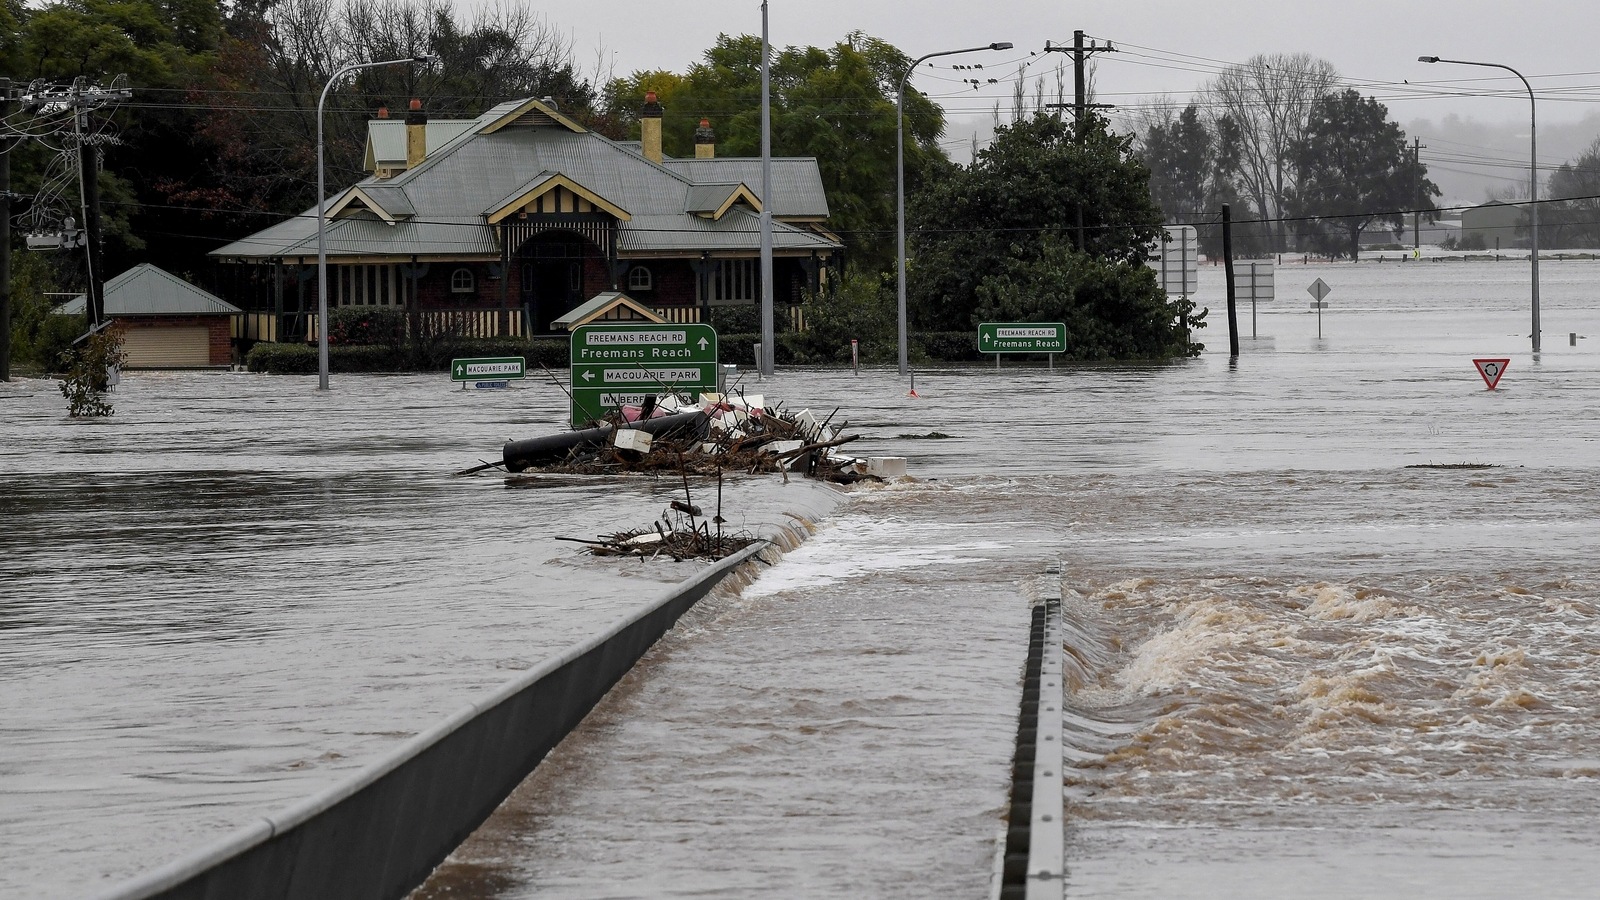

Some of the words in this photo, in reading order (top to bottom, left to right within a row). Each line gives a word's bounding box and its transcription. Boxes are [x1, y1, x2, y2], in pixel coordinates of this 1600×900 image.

[589, 334, 635, 342] FREEMANS
[640, 334, 667, 342] REACH
[581, 348, 644, 358] Freemans
[652, 347, 691, 357] Reach
[468, 365, 501, 373] MACQUARIE
[606, 371, 665, 380] MACQUARIE
[670, 371, 697, 379] PARK
